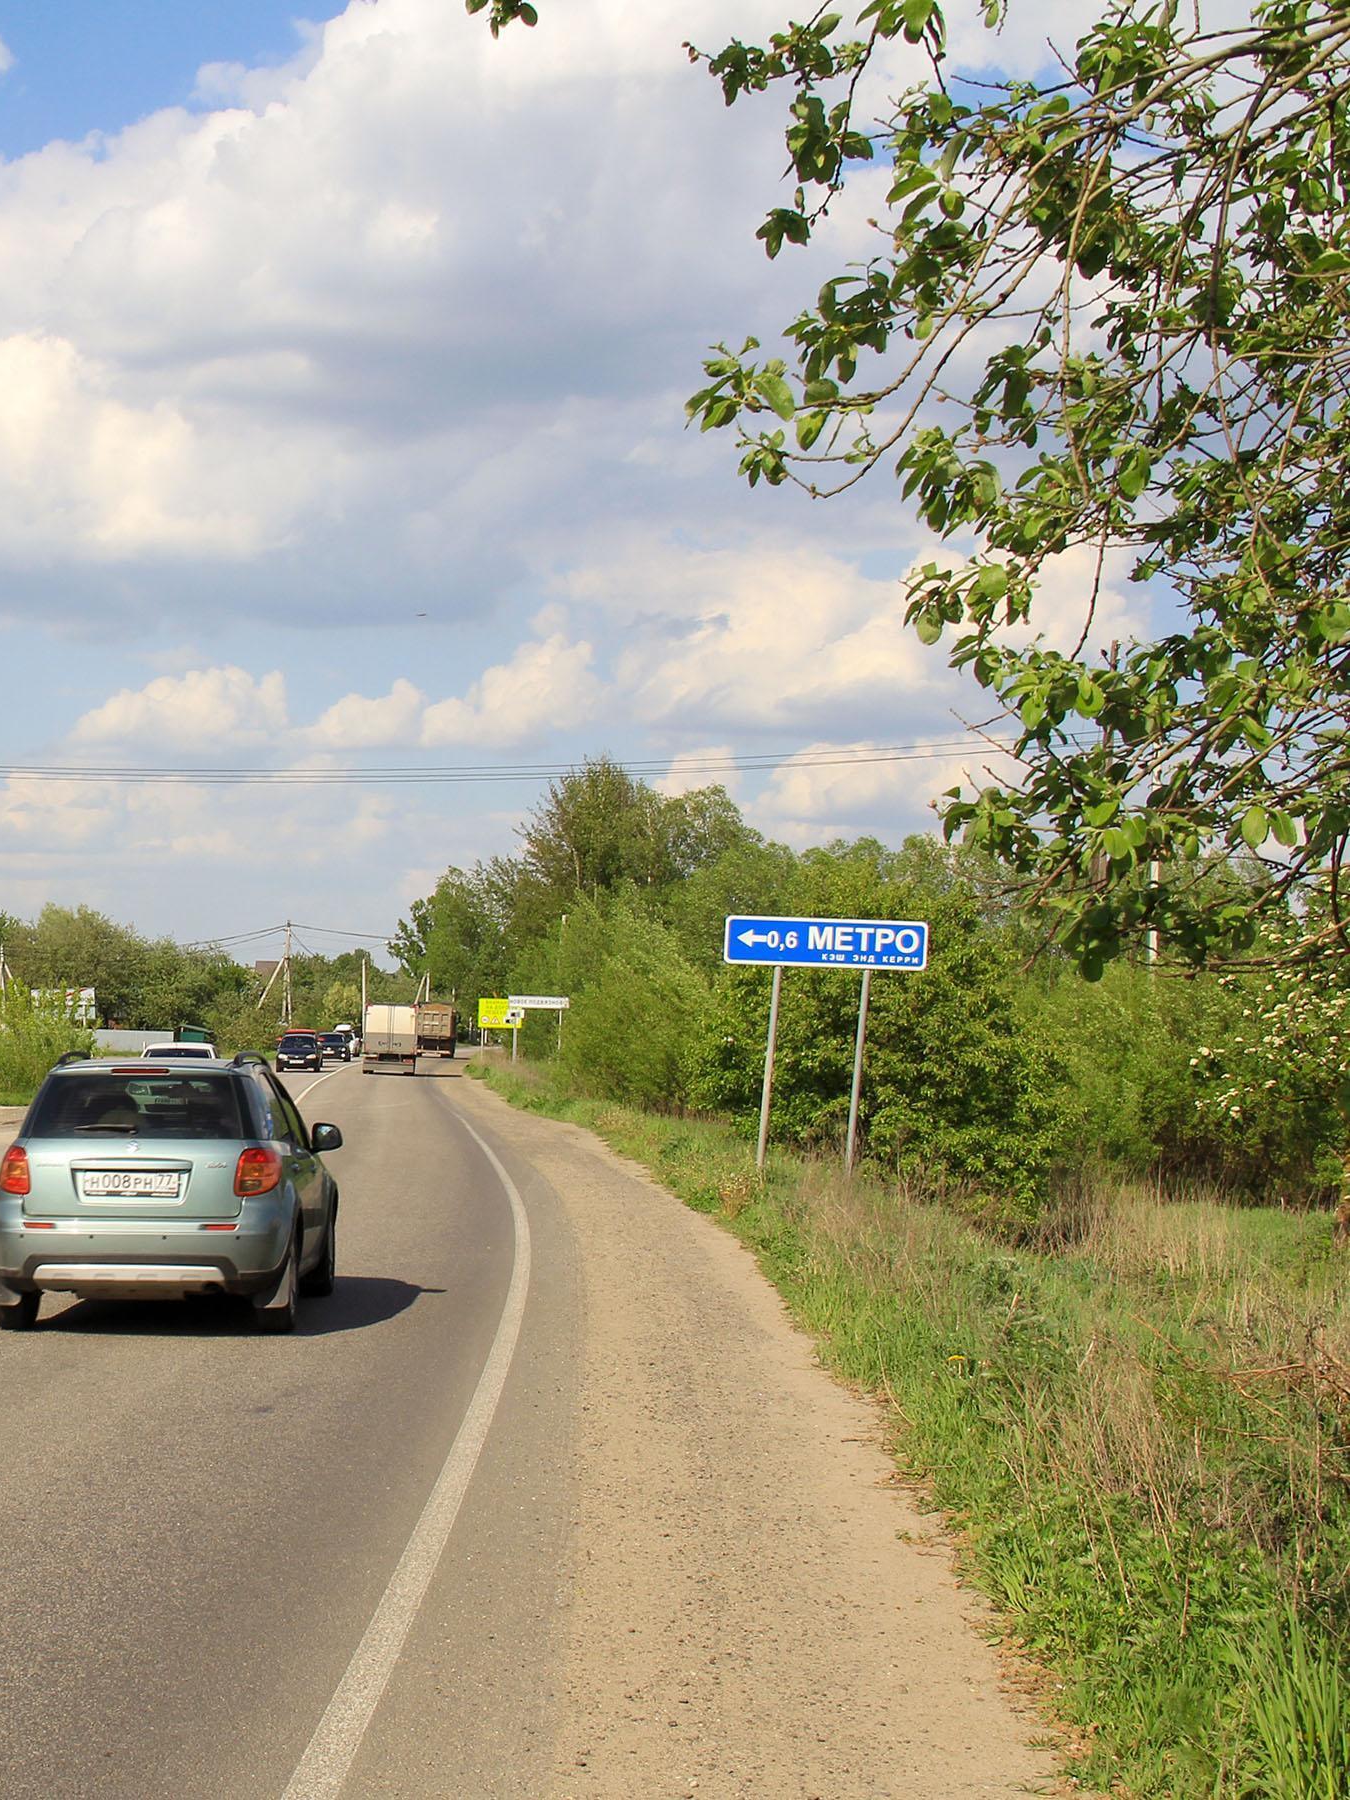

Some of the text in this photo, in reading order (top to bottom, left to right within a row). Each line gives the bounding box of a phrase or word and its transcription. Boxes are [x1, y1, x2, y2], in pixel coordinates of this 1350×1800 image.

[766, 926, 919, 954] 0,6 МЕТРО
[821, 953, 919, 964] КЭШ ЭНД КЕРРИ
